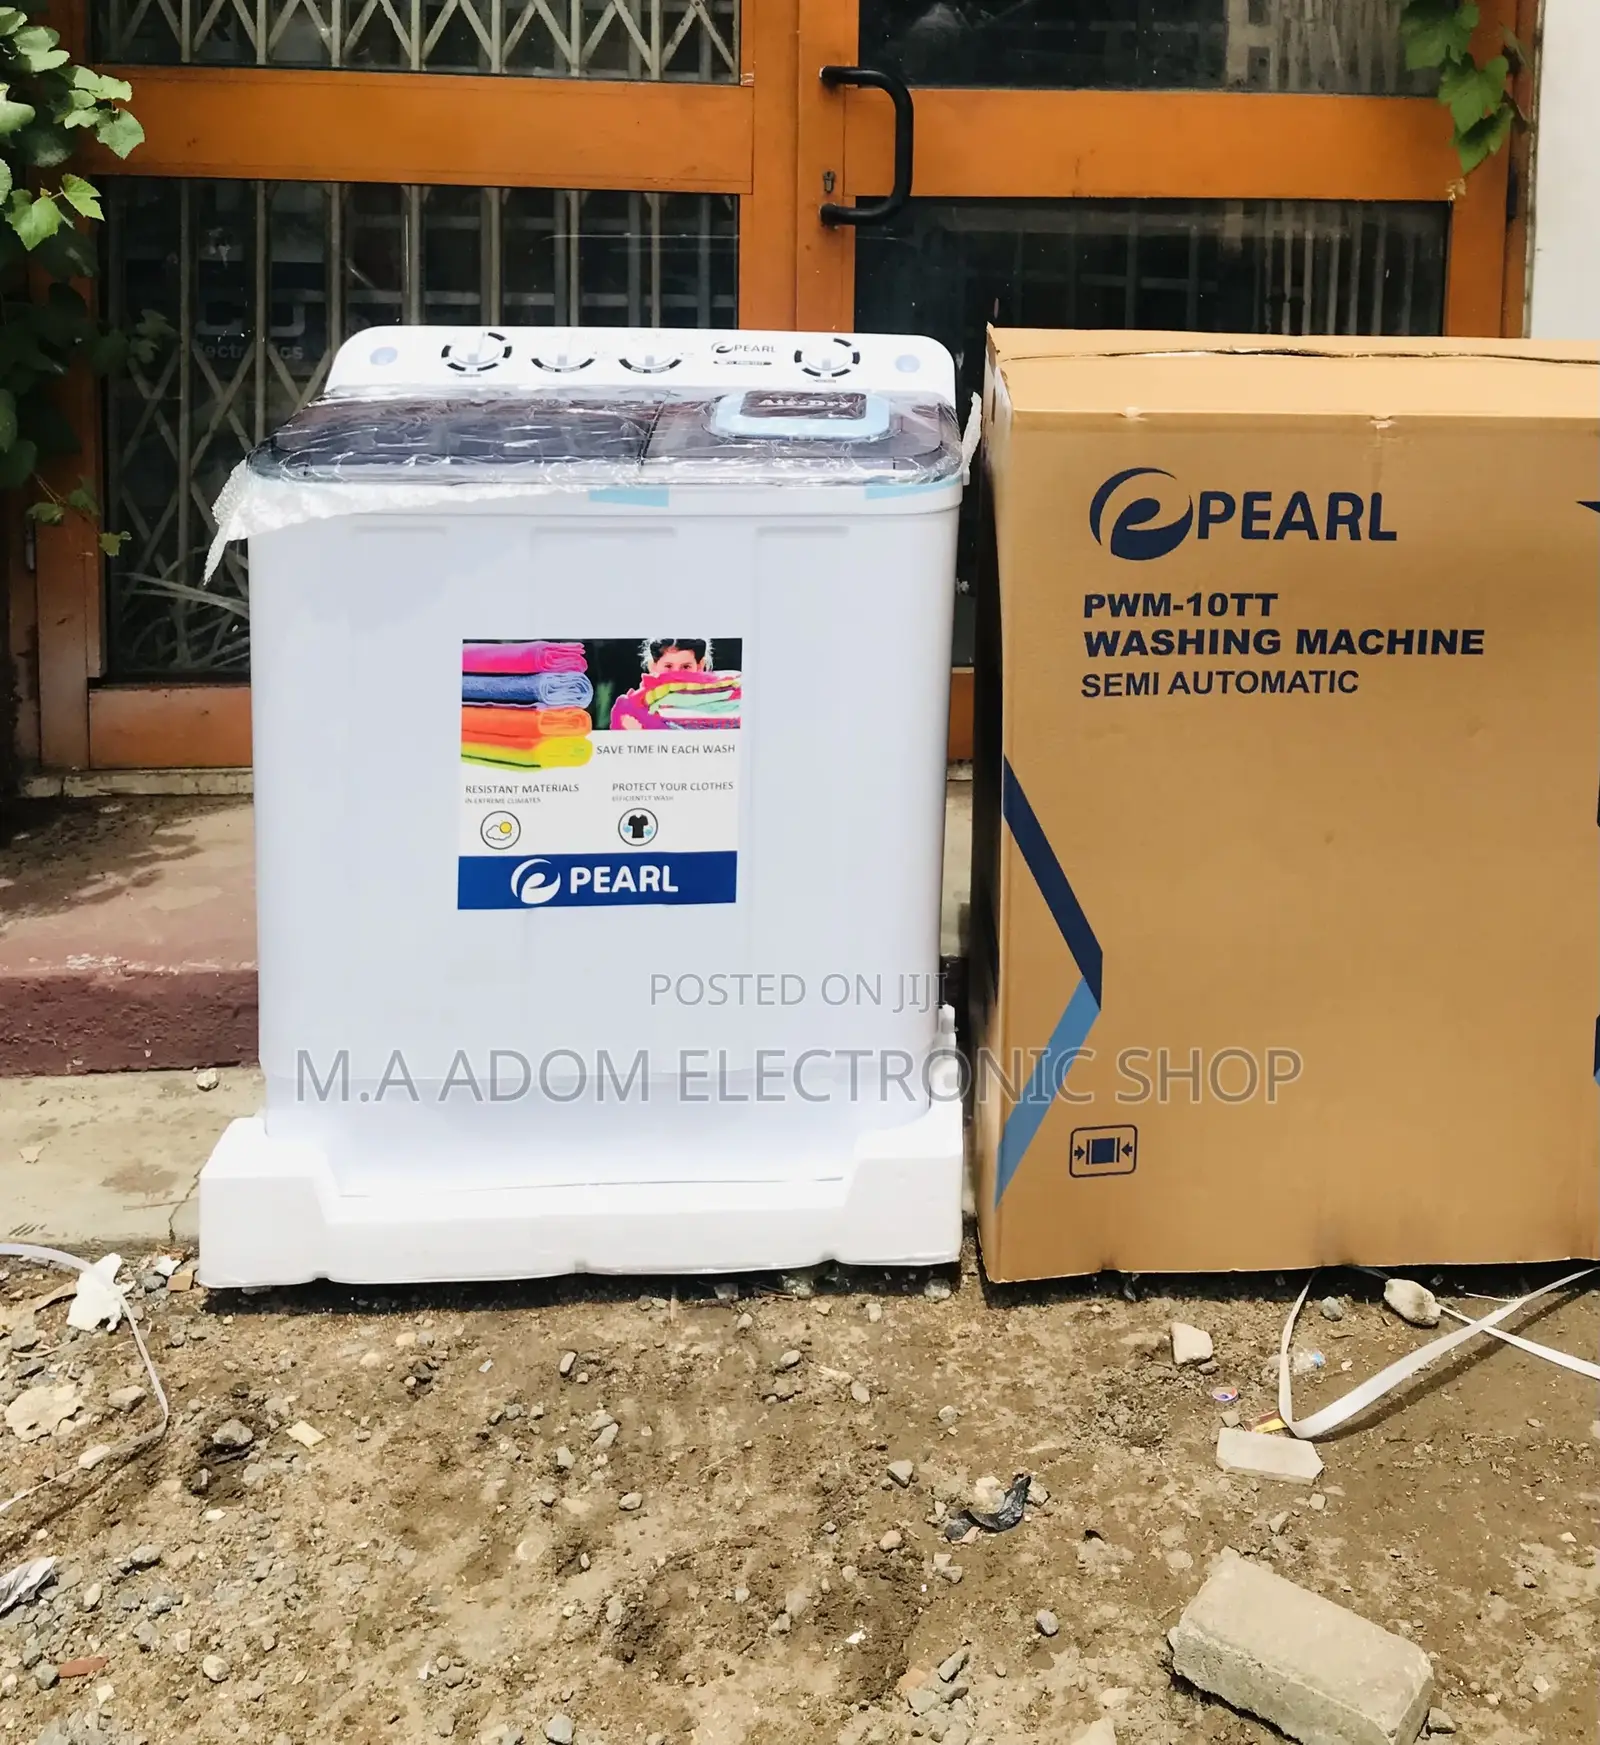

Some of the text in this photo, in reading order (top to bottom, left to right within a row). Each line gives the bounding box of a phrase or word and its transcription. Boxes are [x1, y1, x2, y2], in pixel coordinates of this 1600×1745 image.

[733, 343, 776, 354] PEARL
[1197, 490, 1398, 542] PEARL
[1083, 592, 1279, 618] PWM-10TT
[1083, 628, 1485, 658] WASHING MACHINE
[1081, 670, 1359, 698] SEMI AUTOMATIC
[596, 744, 736, 755] SAVE TIME IN EACH WASH
[465, 784, 580, 794] RESISTANT MATERIALS
[612, 781, 734, 791] PROTECT YOUR CLOTHES
[569, 865, 679, 894] PEARL
